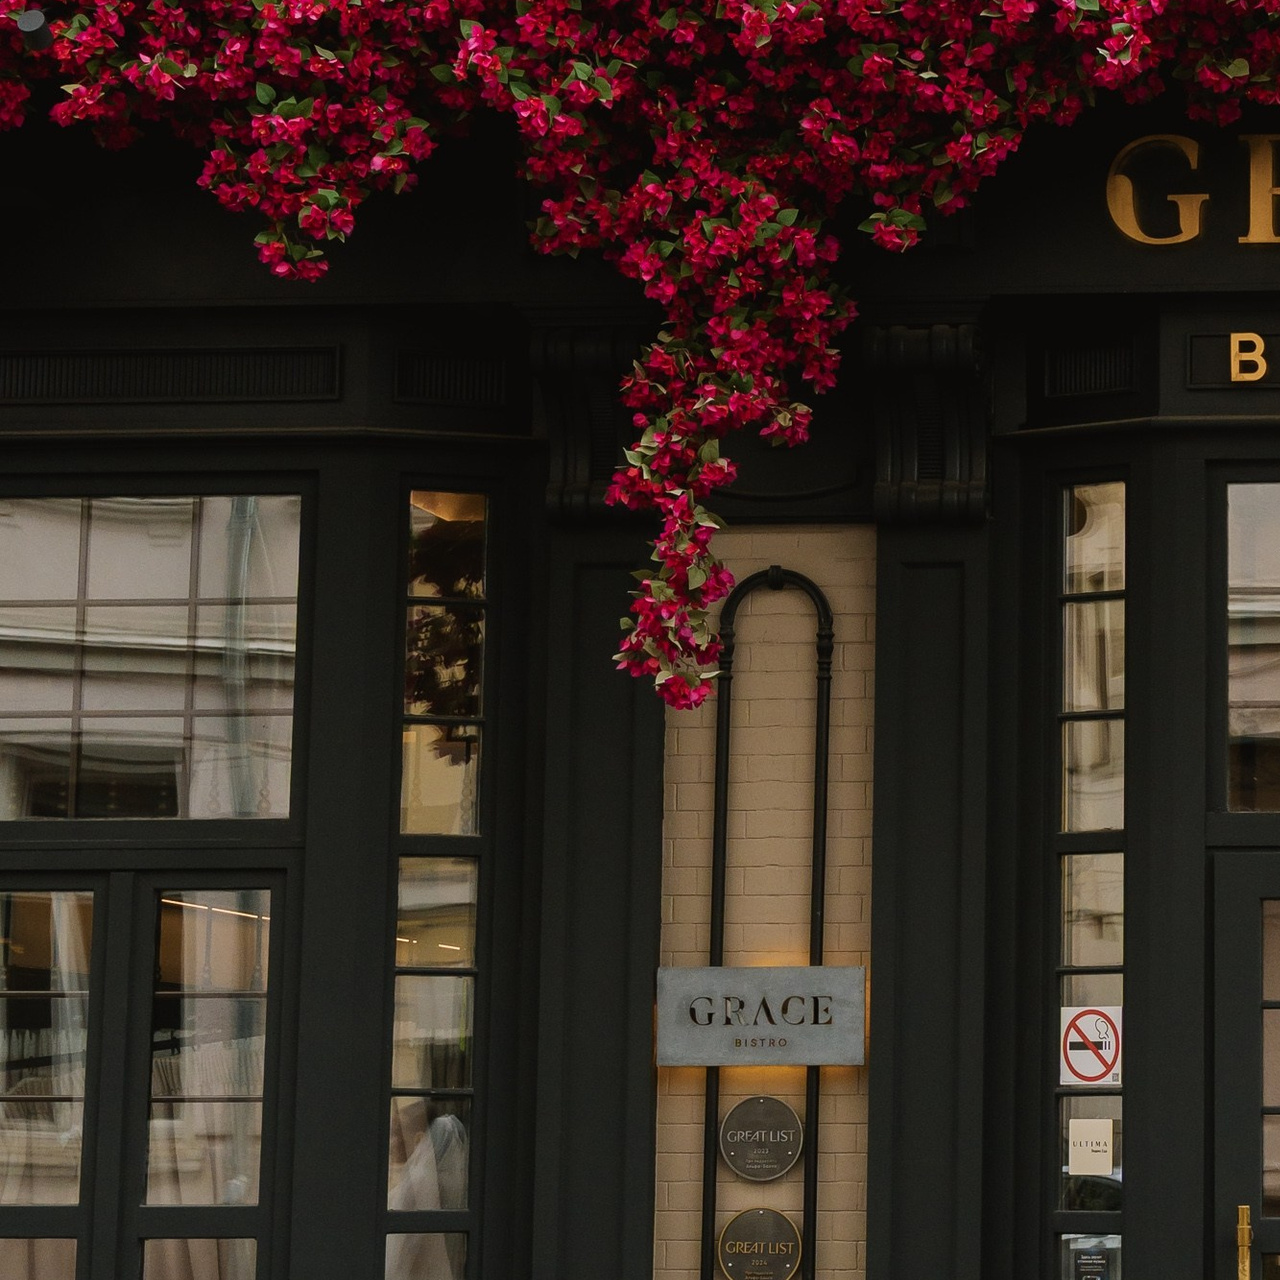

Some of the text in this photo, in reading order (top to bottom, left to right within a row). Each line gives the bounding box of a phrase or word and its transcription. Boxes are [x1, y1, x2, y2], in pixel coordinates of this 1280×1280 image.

[688, 995, 834, 1027] GRACE
[734, 1037, 788, 1048] BISTRO
[727, 1129, 796, 1143] GREAT LIST
[725, 1241, 795, 1254] GREAT LIST
